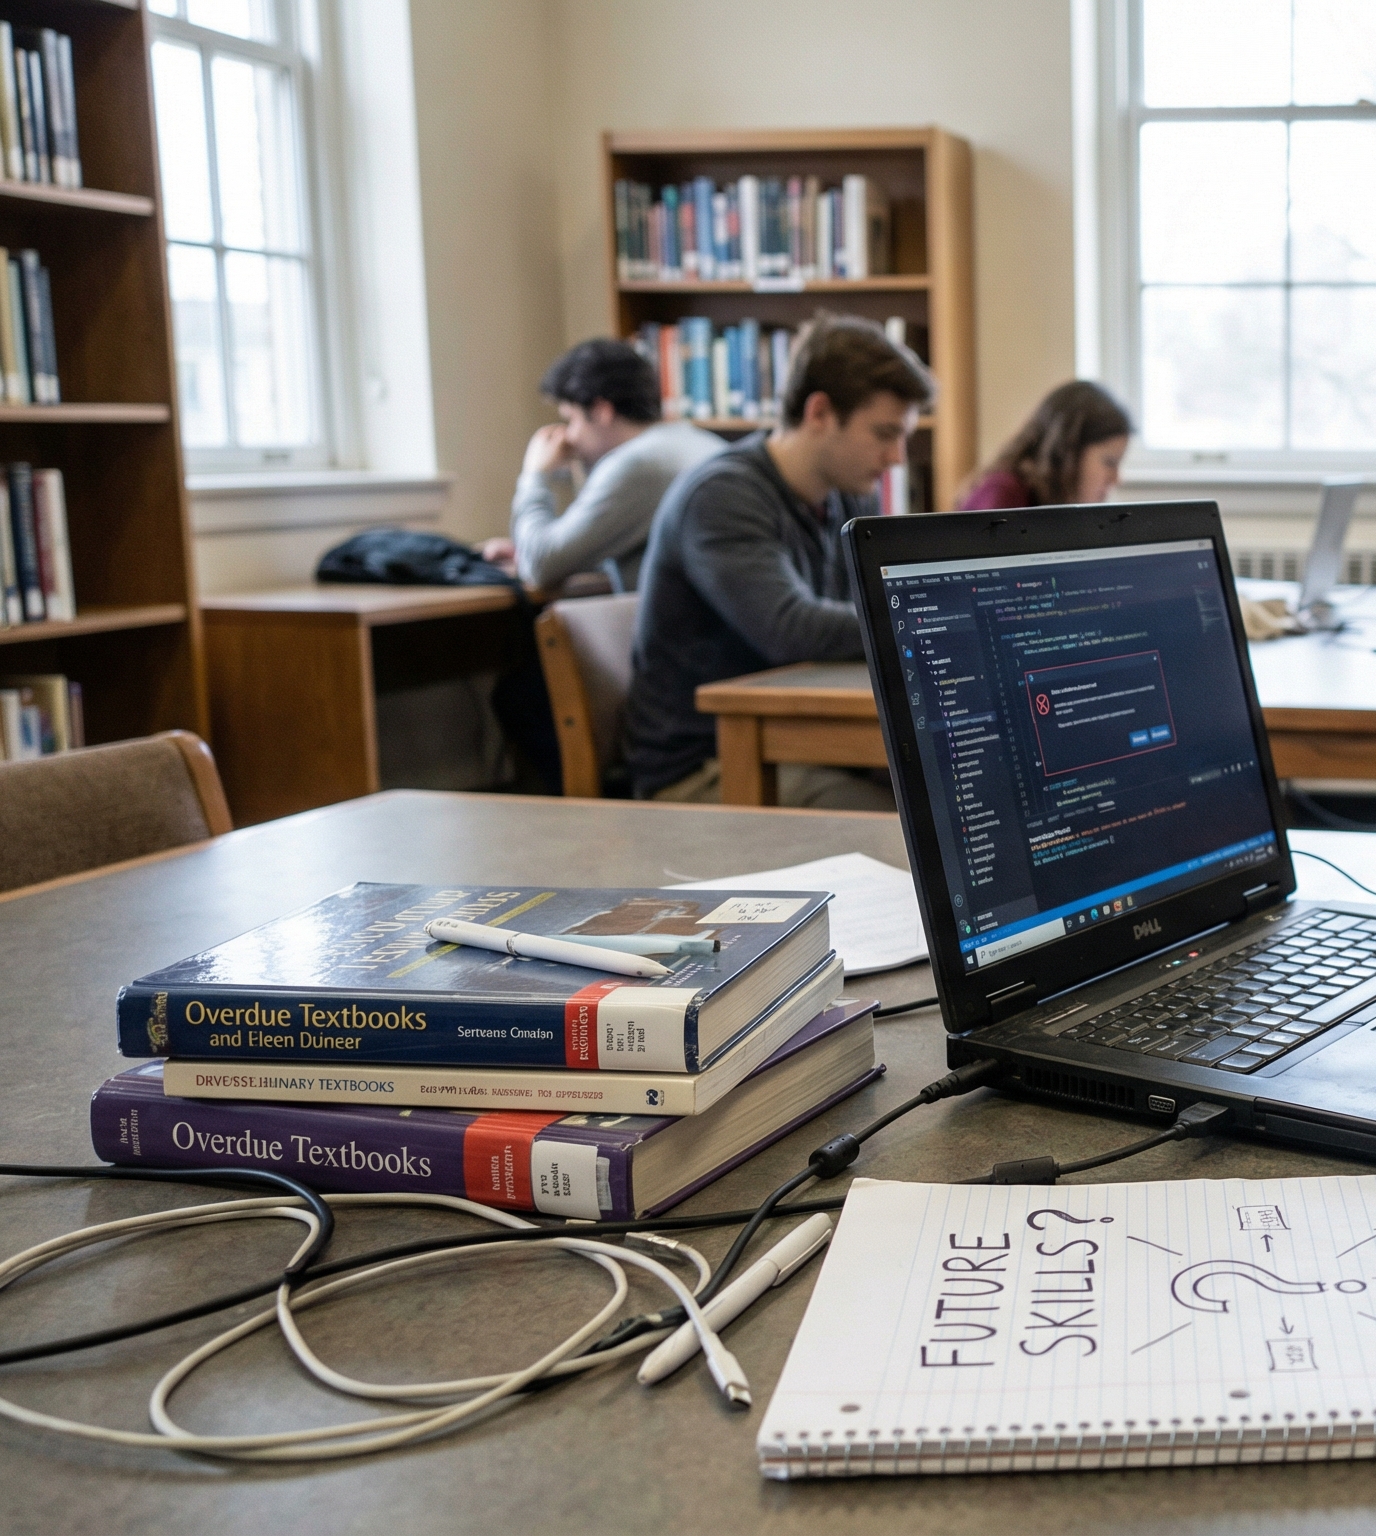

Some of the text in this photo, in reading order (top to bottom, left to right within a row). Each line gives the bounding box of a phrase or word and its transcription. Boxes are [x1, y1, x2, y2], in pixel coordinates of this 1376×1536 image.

[185, 1000, 291, 1027] Overdue
[299, 1003, 427, 1031] Textbooks
[209, 1030, 242, 1047] and
[318, 1078, 394, 1093] TEXTBOOKS
[172, 1121, 284, 1161] Overdue
[290, 1135, 433, 1178] Textbooks
[921, 1233, 1011, 1368] FUTURE
[1019, 1208, 1115, 1357] SKILLS?
